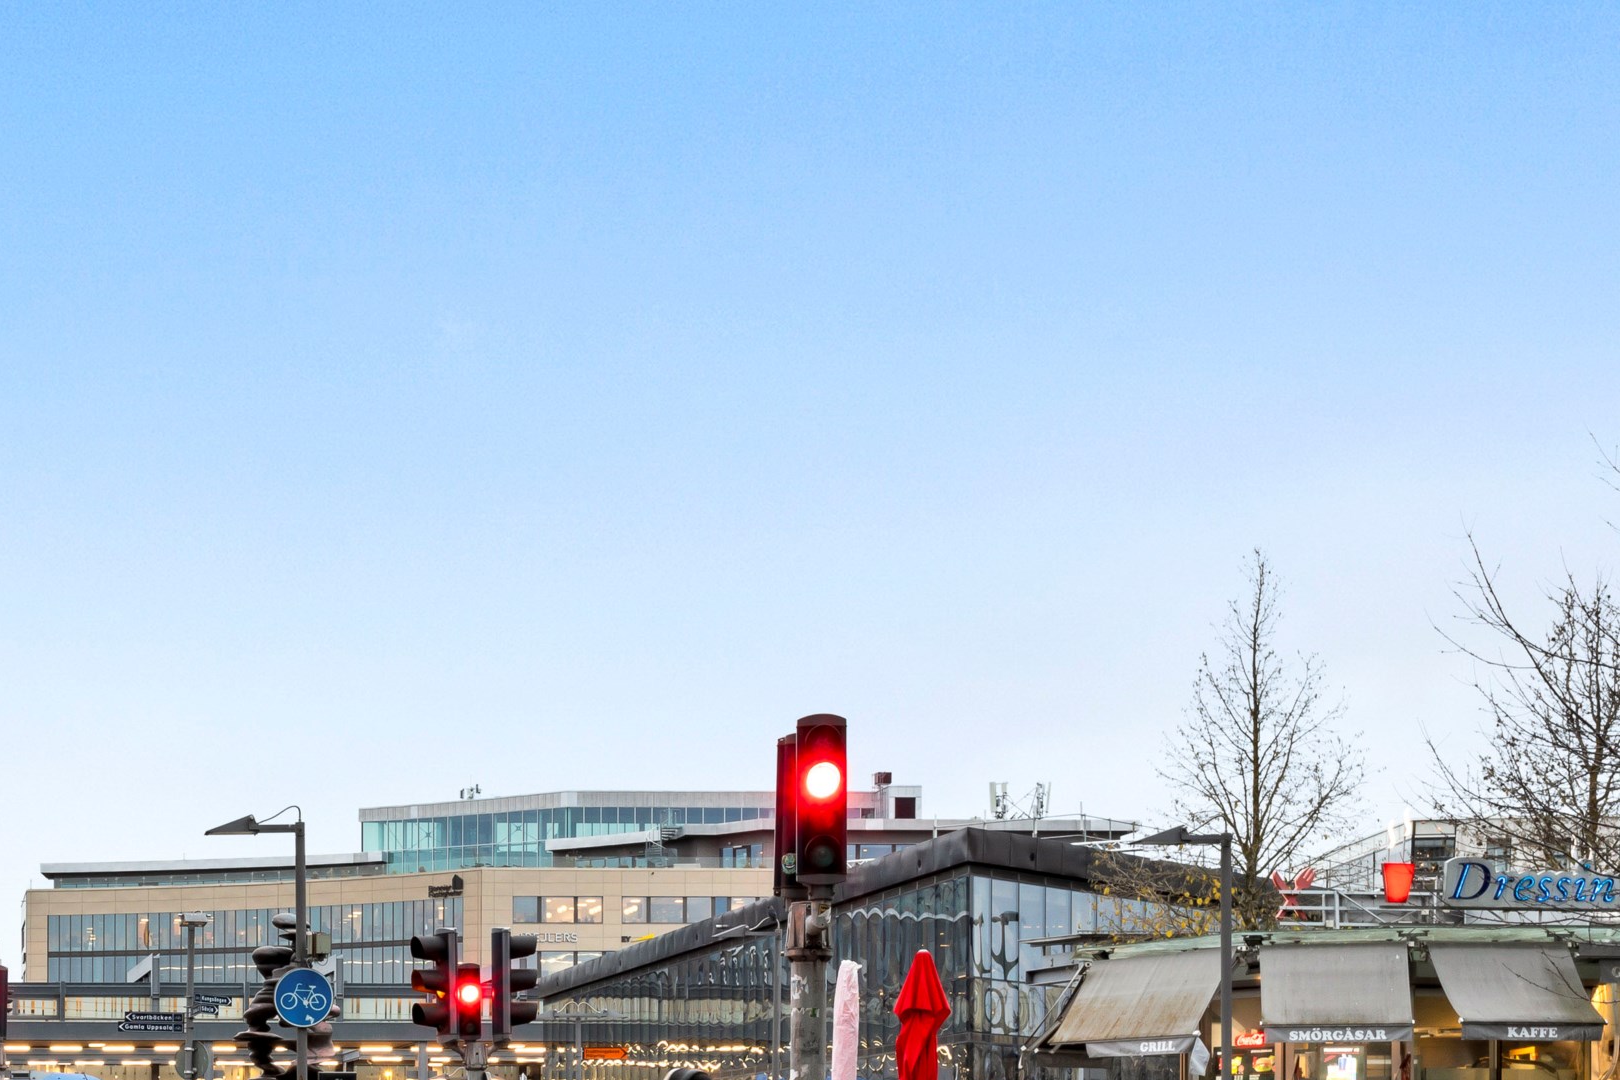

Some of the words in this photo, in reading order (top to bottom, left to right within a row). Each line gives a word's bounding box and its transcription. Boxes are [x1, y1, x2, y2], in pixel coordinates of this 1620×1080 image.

[525, 932, 578, 944] EJLERS
[621, 935, 631, 943] EY
[131, 1013, 173, 1021] Svartbäcken
[1288, 1026, 1387, 1042] SMÖRGÅSAR
[1507, 1026, 1558, 1039] KAFFE
[1139, 1040, 1176, 1053] GRILL
